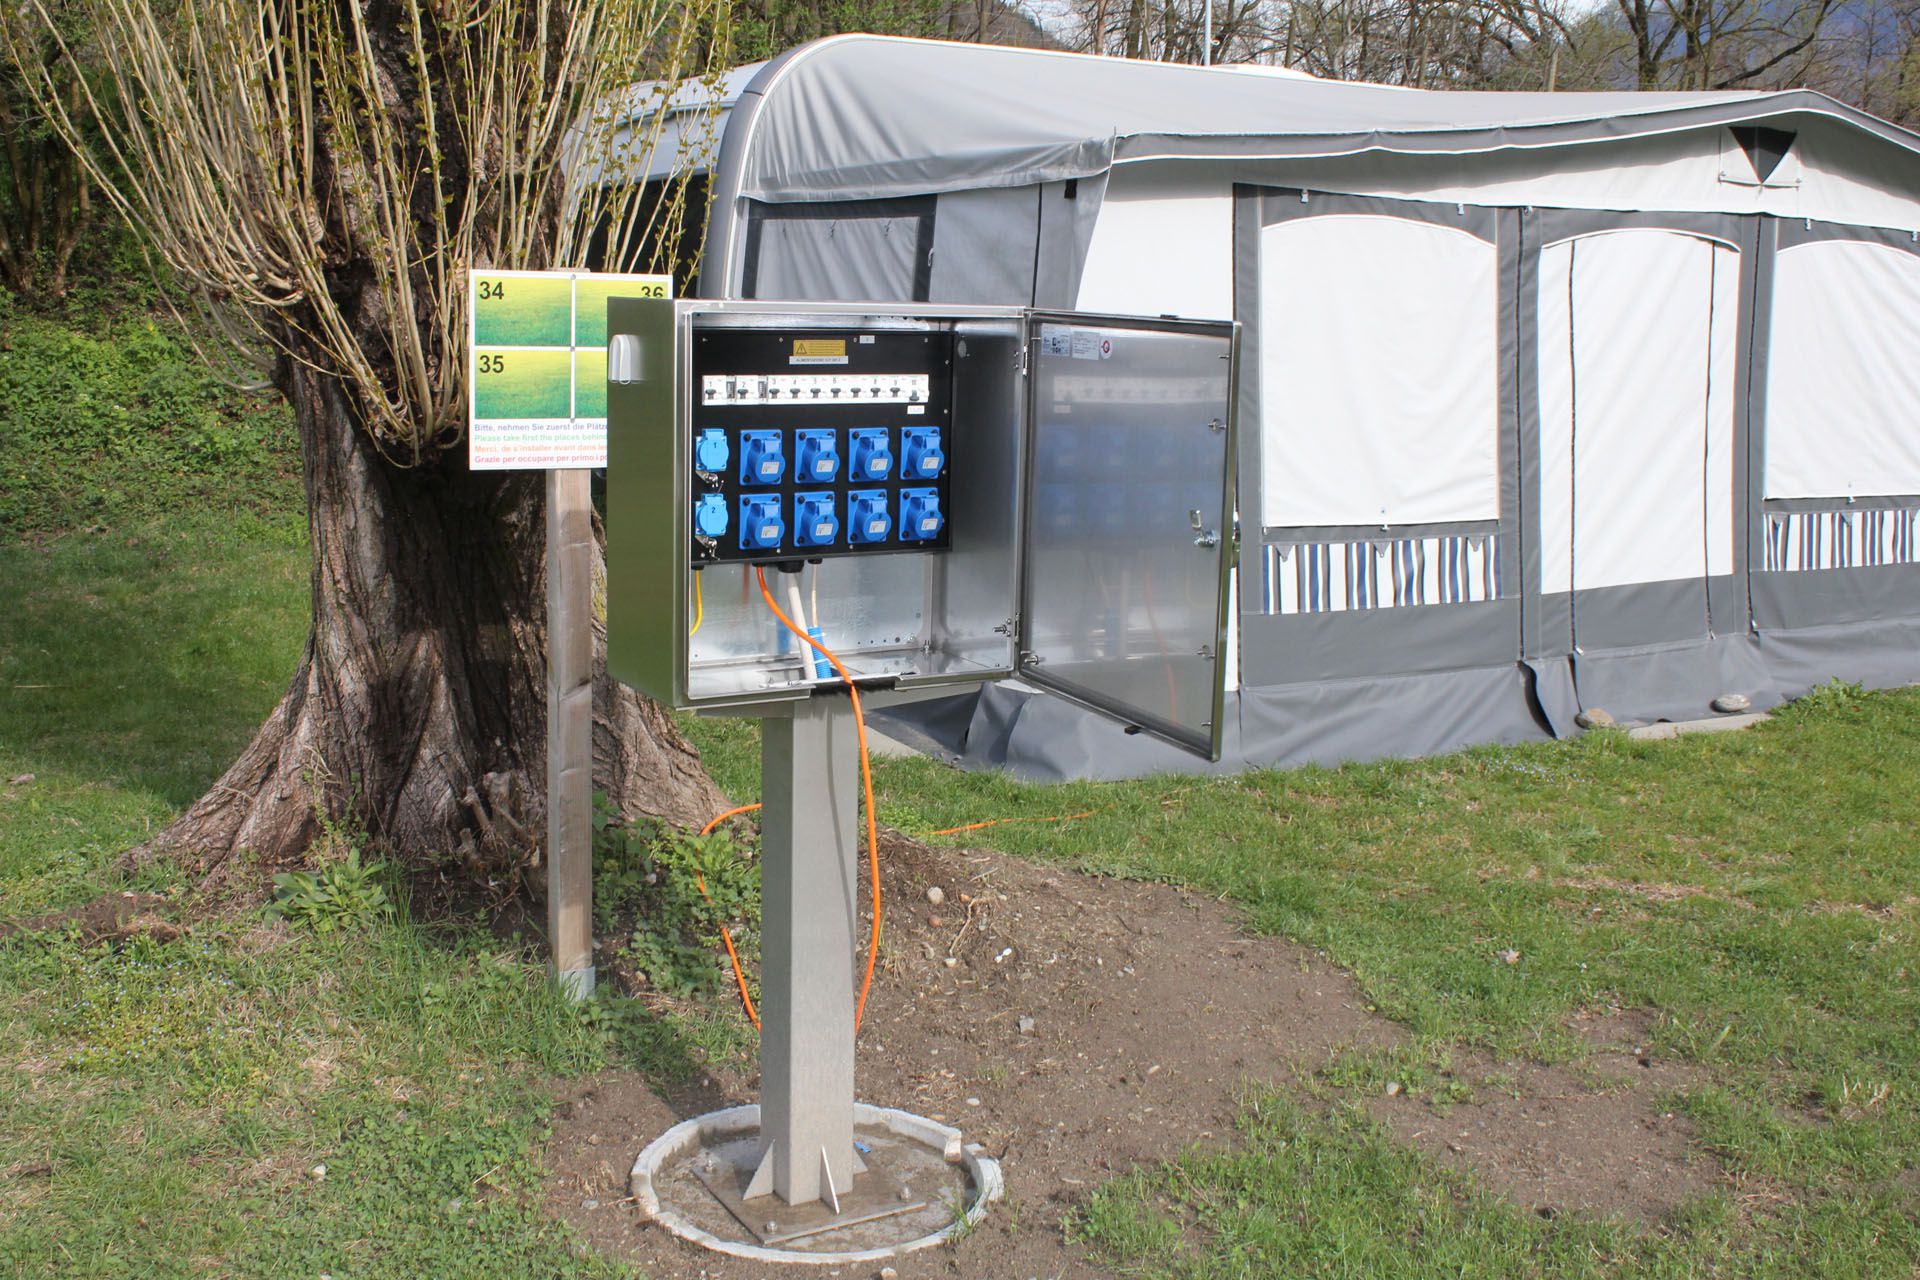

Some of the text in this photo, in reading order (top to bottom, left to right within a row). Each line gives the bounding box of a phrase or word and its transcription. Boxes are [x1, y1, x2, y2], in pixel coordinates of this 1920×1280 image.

[479, 281, 504, 300] 34
[641, 286, 664, 298] 36
[479, 355, 504, 374] 35
[474, 424, 495, 432] Bitte,
[474, 434, 500, 442] Please
[554, 433, 580, 442] places
[502, 456, 516, 464] per
[518, 456, 554, 464] occupare
[556, 456, 570, 464] per
[572, 454, 595, 464] primo
